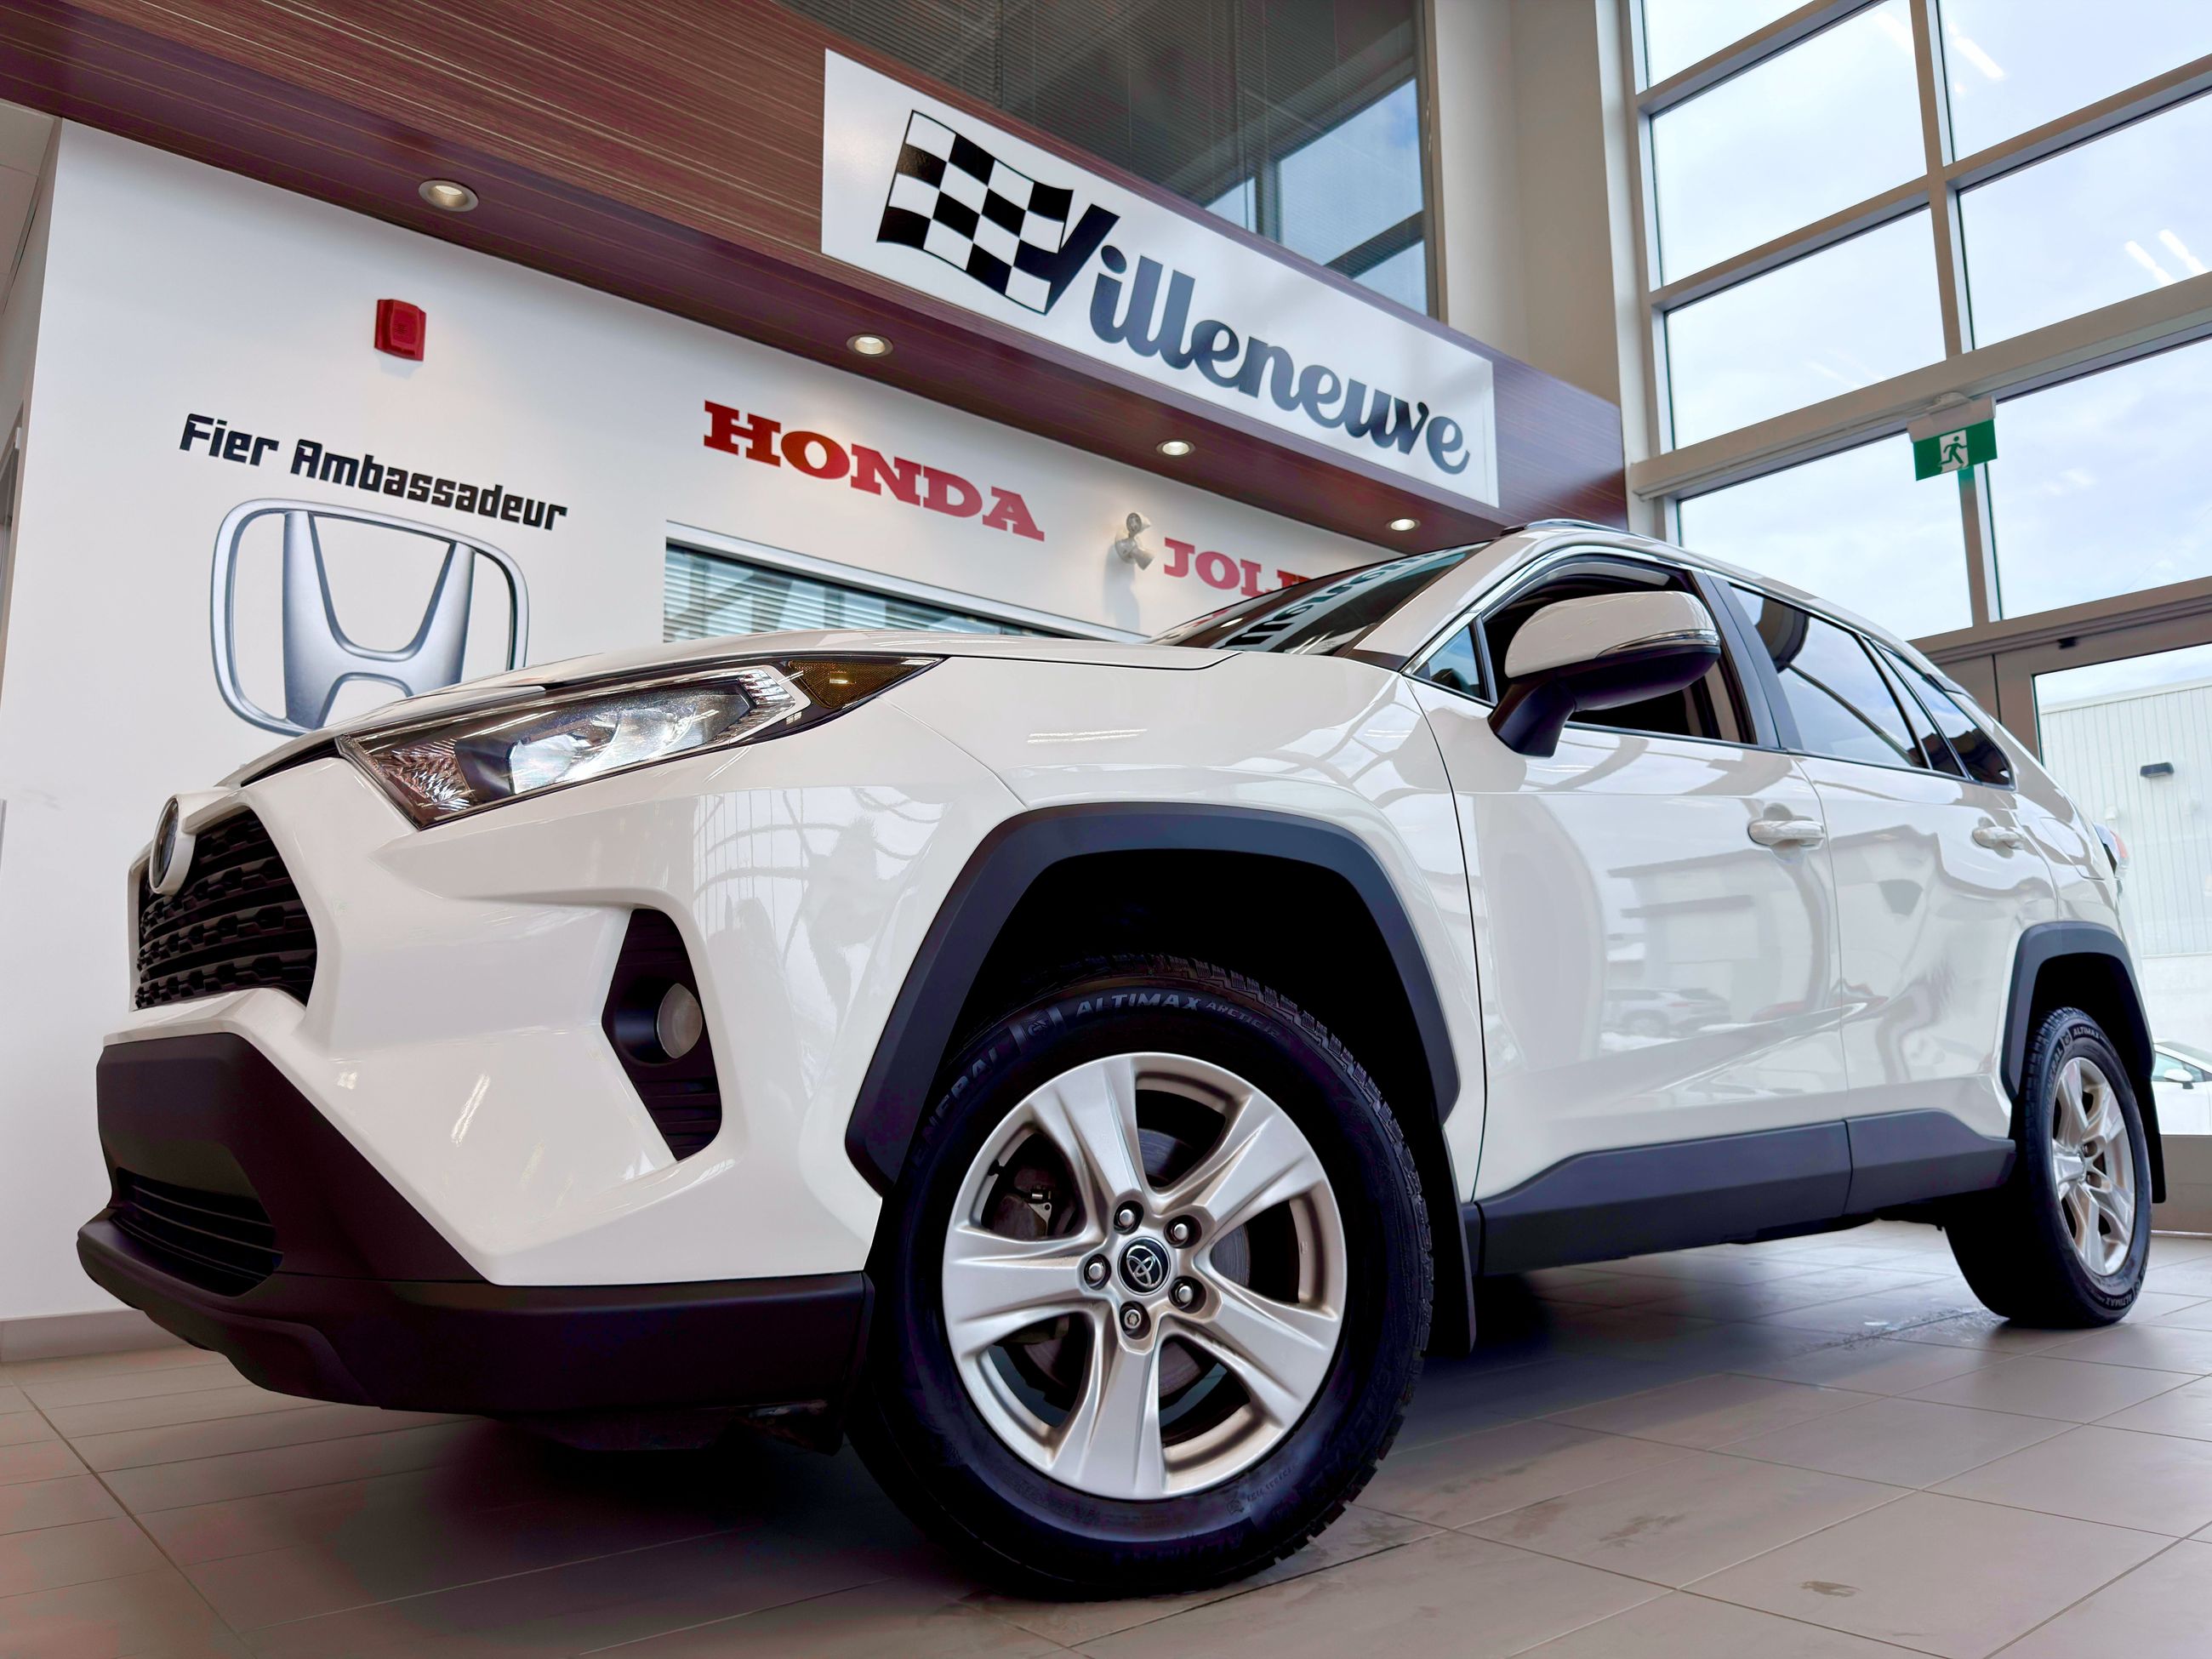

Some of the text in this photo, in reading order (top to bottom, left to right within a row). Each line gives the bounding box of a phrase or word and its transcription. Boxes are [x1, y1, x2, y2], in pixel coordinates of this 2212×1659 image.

[1017, 204, 1470, 476] Villeneuve
[180, 413, 568, 531] Fier Ambassadeur
[704, 400, 1311, 597] HONDA JOL
[1075, 992, 1201, 1018] ALTIMAX
[1206, 1000, 1263, 1029] ARCTIC
[2072, 1026, 2100, 1040] ALTIMAX
